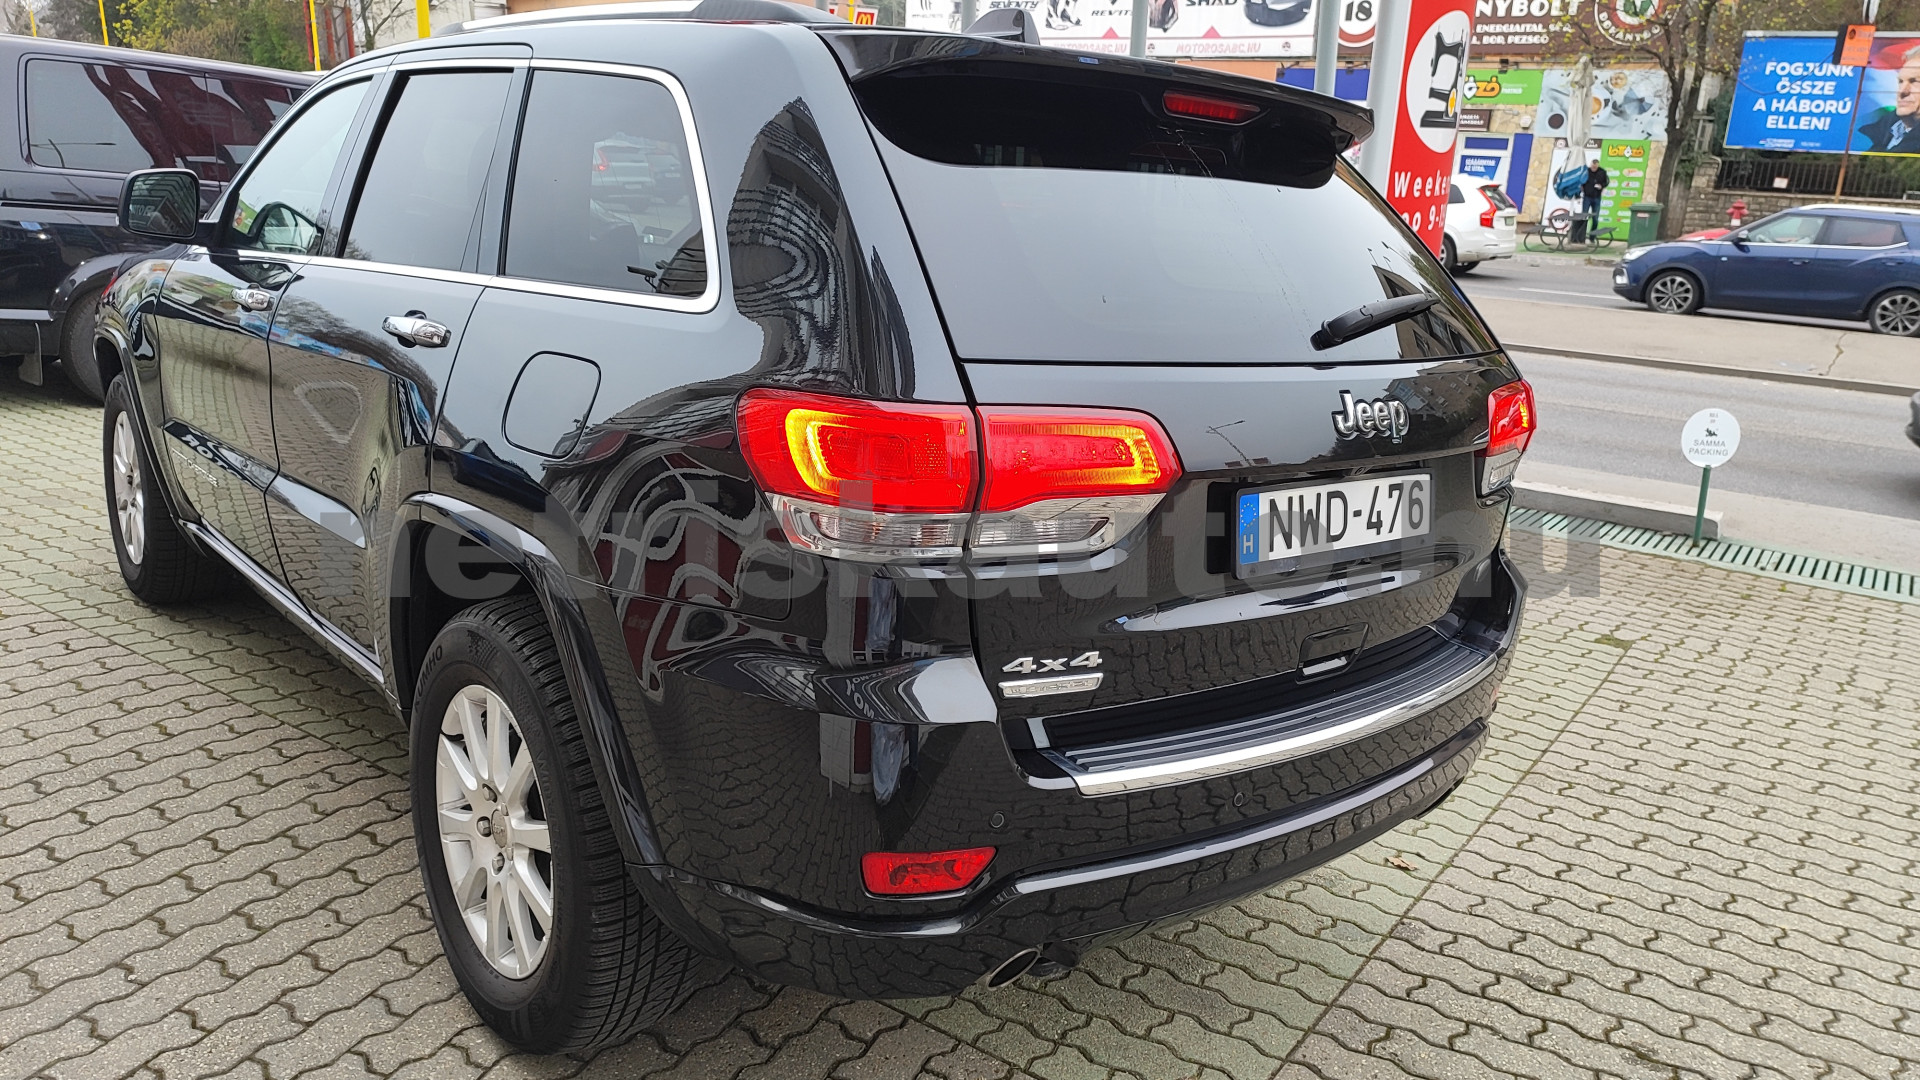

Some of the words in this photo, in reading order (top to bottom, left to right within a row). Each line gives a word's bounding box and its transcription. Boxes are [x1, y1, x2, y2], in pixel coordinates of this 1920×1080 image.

[989, 0, 1038, 9] SEVENTY
[1345, 1, 1373, 21] 18
[1765, 61, 1854, 77] FOGJUNK
[1775, 77, 1837, 95] ÖSSZE
[1752, 98, 1767, 111] A
[1770, 96, 1852, 114] HÁBORÚ
[1766, 115, 1831, 131] ELLEN!
[1332, 390, 1409, 444] Jeep
[1693, 439, 1726, 447] SAMMA
[1269, 480, 1424, 553] NWD-476
[1243, 534, 1254, 554] H
[1002, 651, 1103, 674] 4x4
